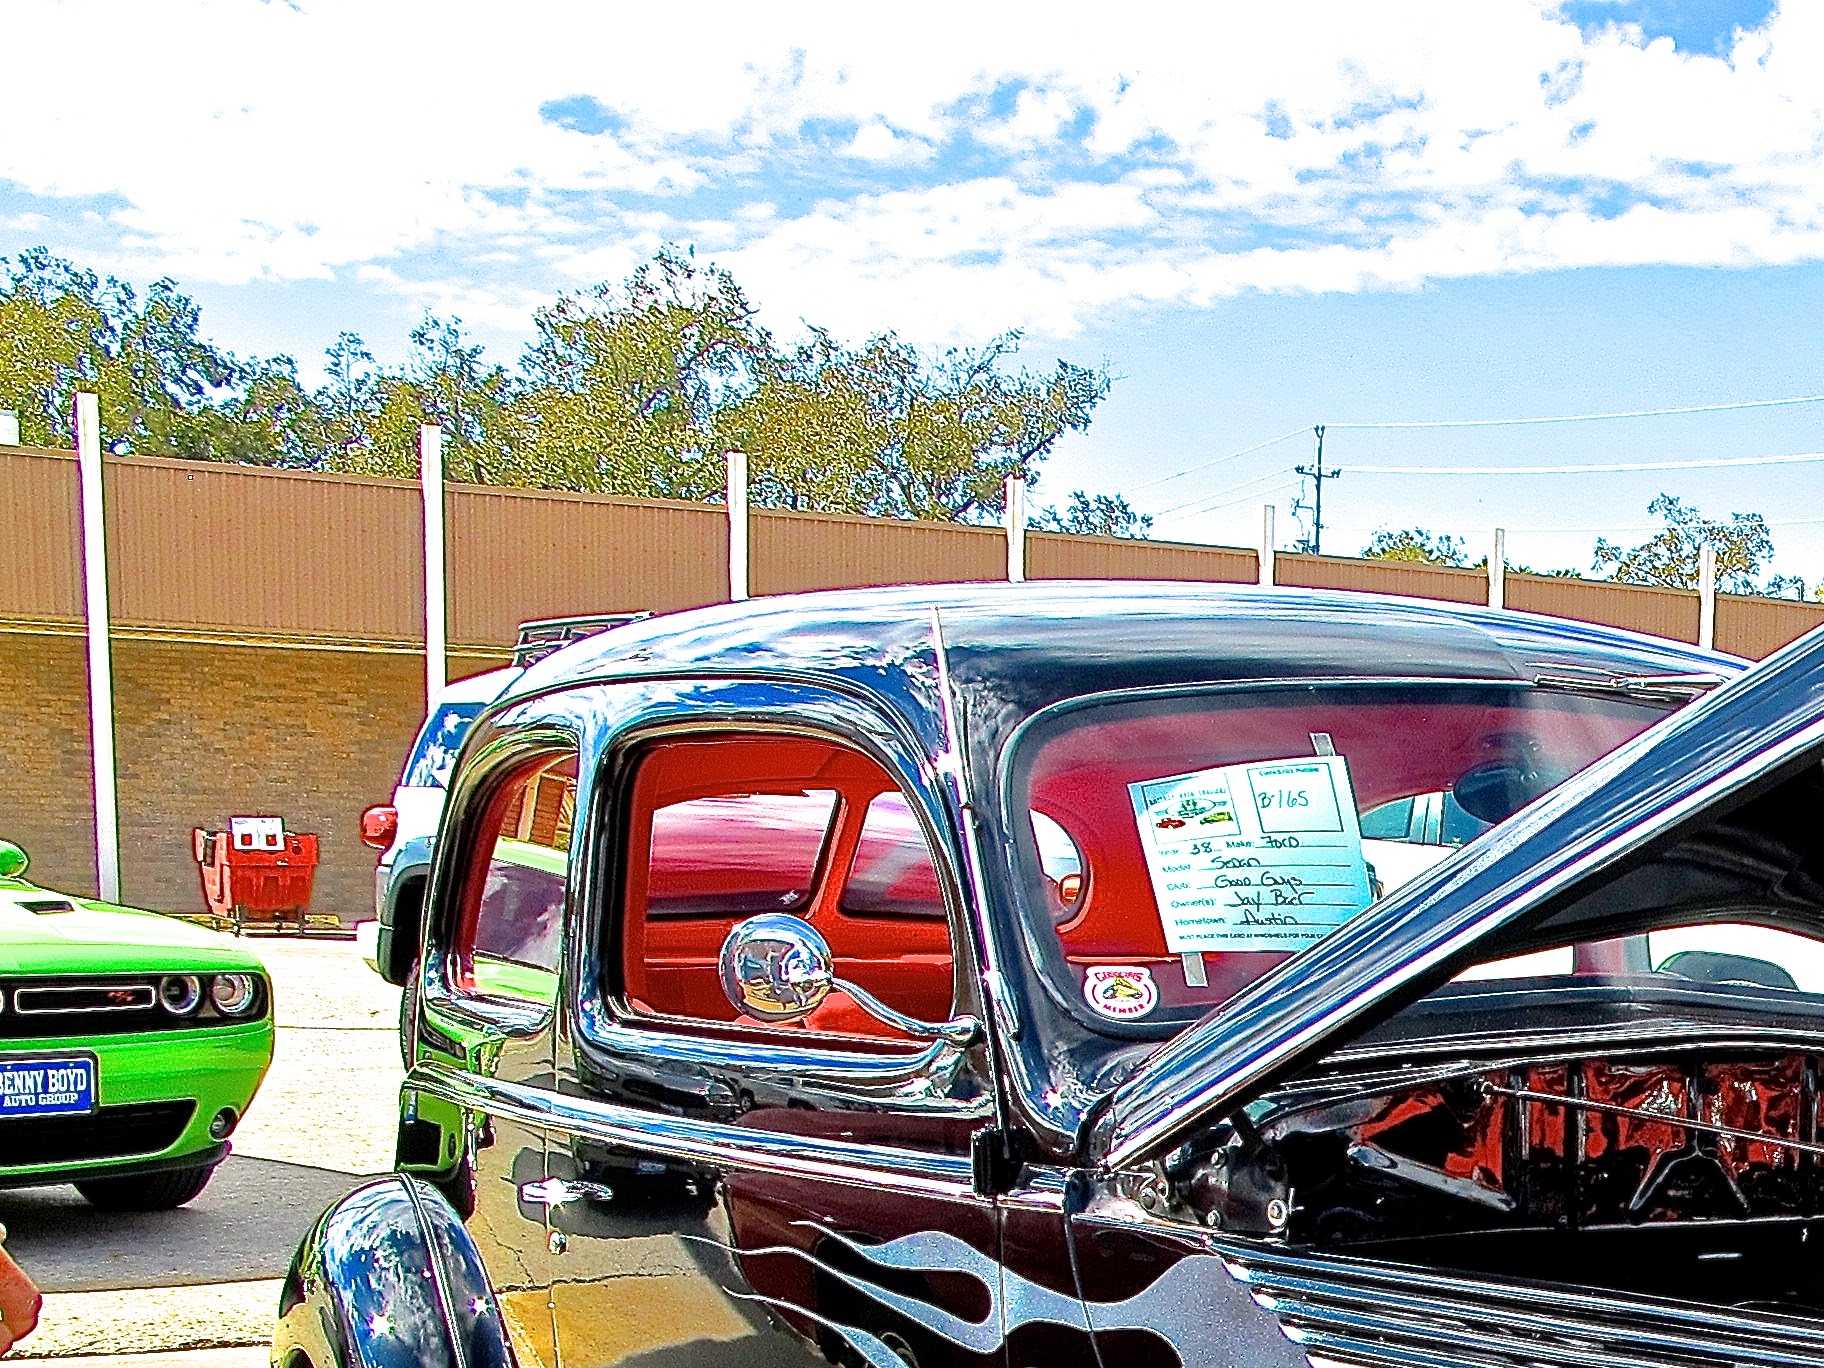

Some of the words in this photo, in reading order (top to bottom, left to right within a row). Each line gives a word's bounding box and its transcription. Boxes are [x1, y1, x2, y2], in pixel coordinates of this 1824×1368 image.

[1189, 841, 1213, 855] 38
[1102, 1003, 1146, 1014] MEMBER
[47, 1068, 87, 1093] BOYD
[3, 1094, 36, 1107] AUTO
[38, 1092, 79, 1106] GROUP
